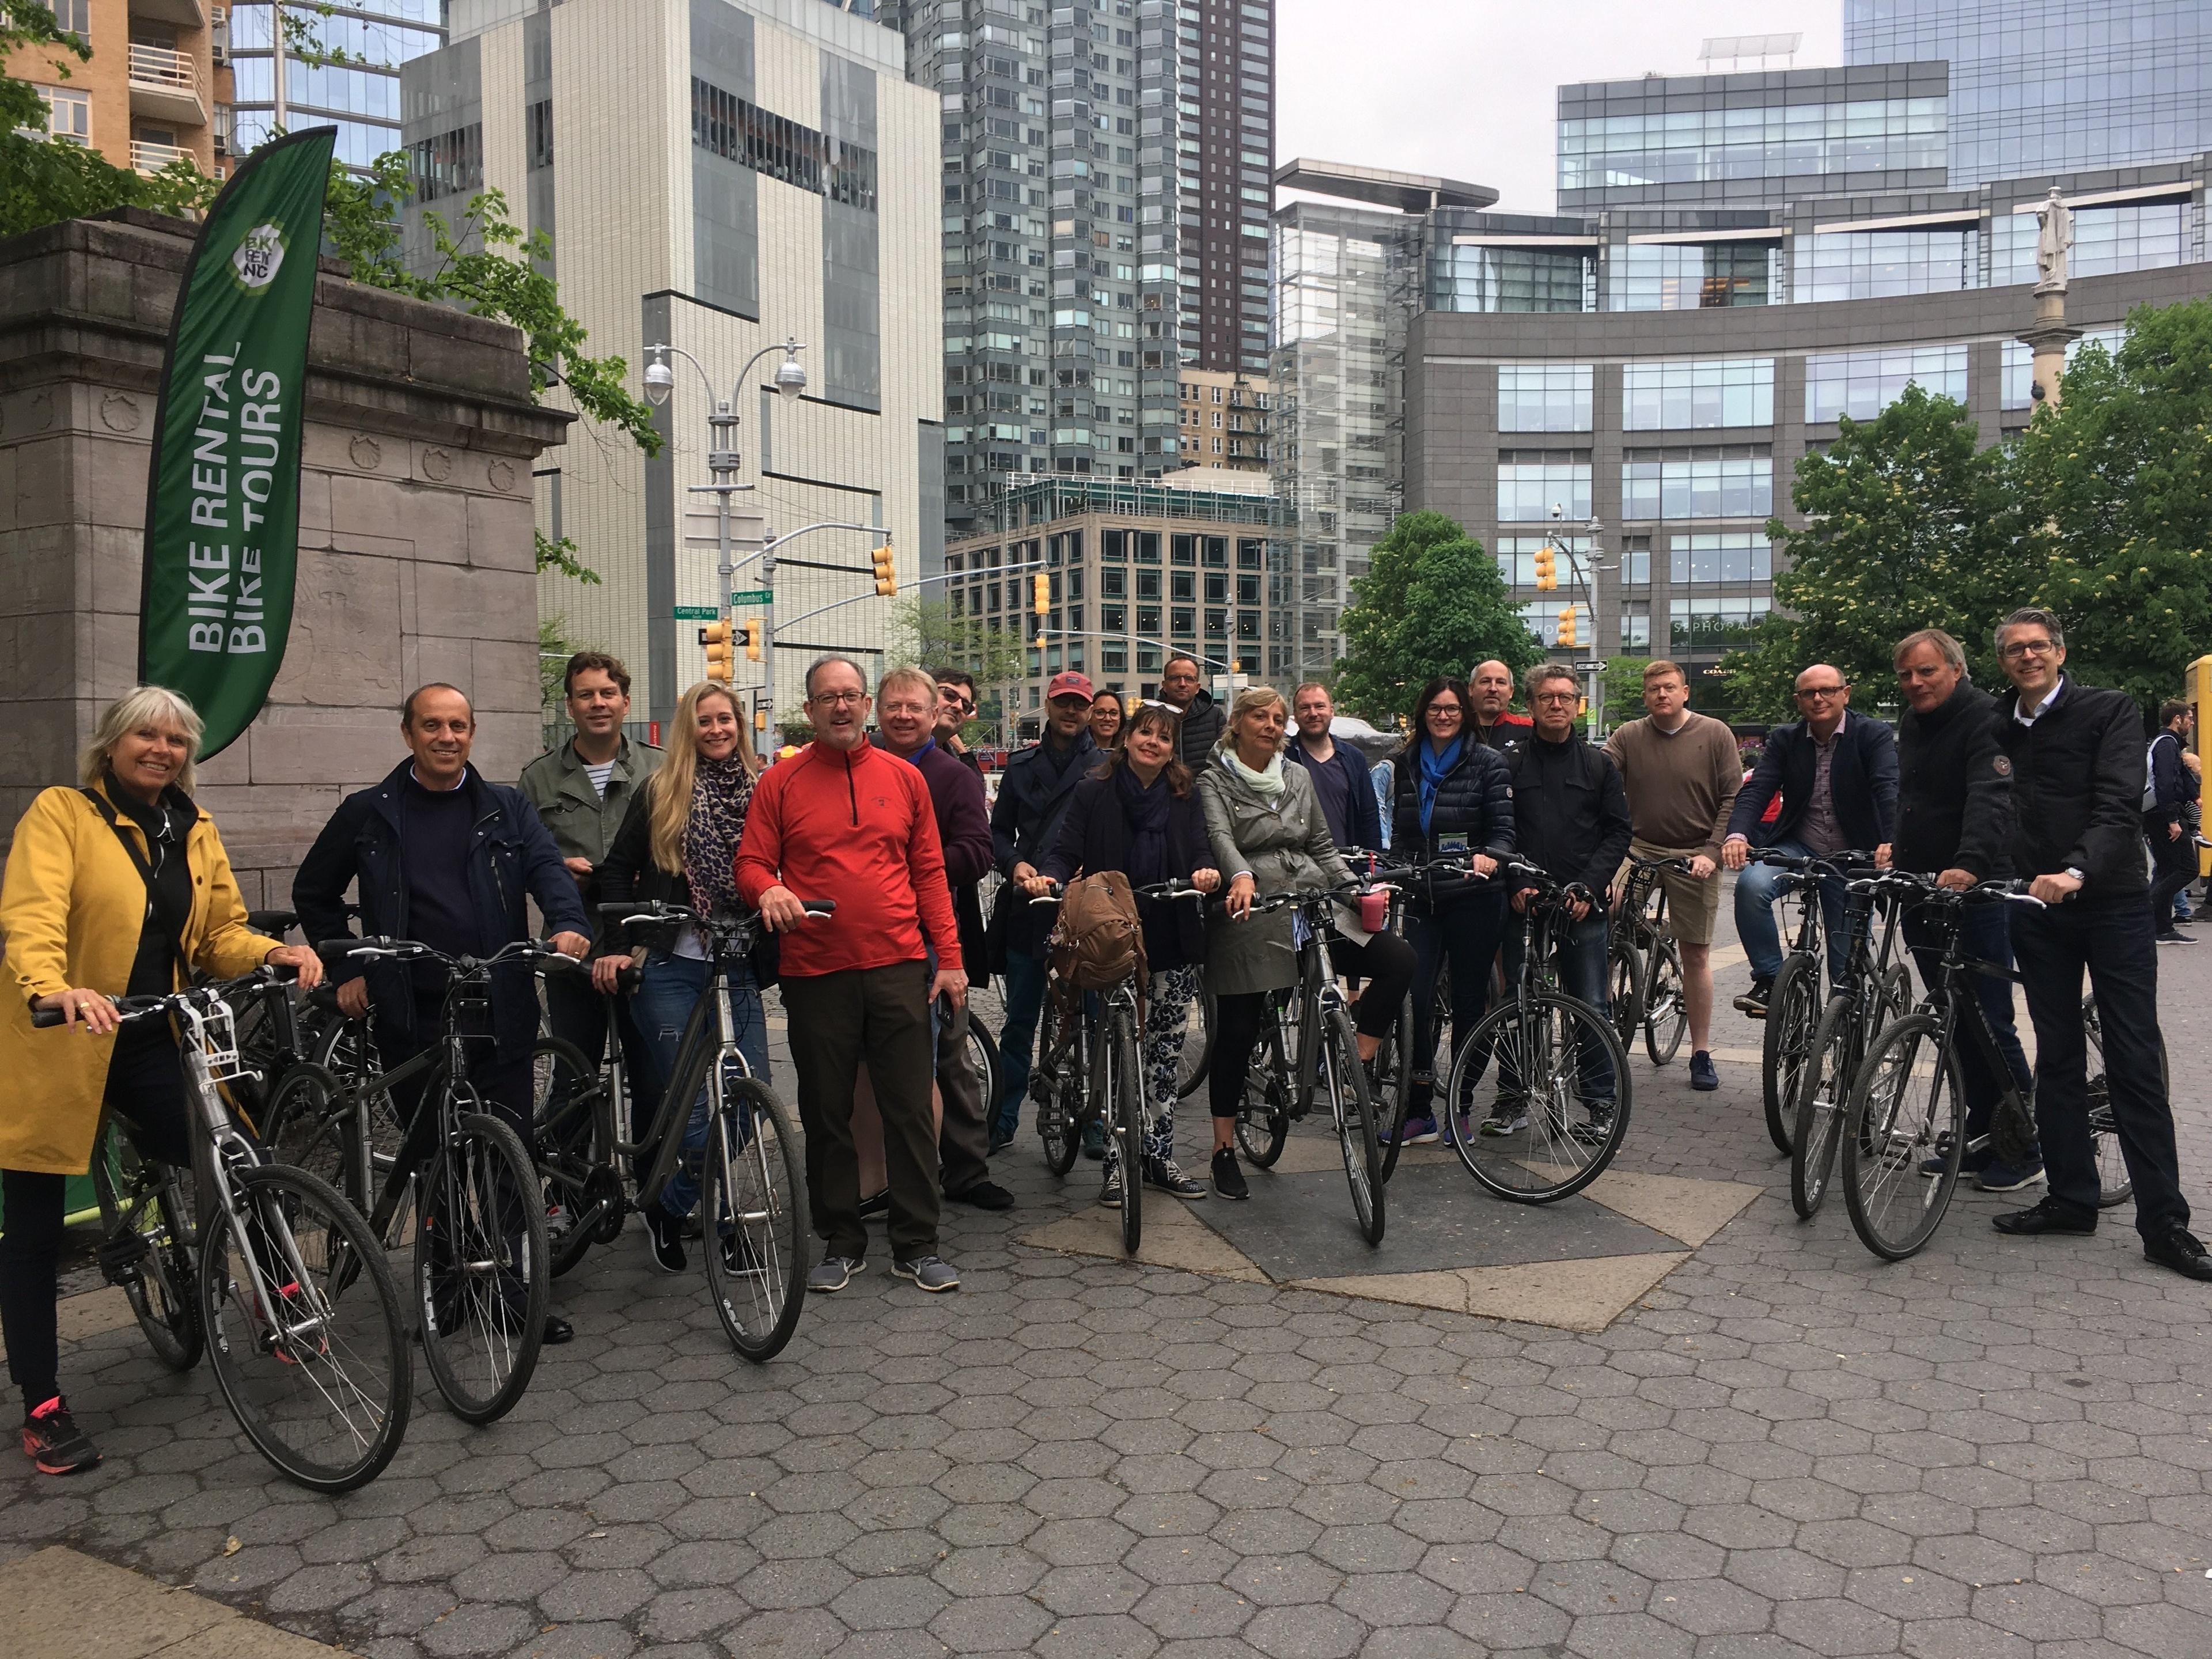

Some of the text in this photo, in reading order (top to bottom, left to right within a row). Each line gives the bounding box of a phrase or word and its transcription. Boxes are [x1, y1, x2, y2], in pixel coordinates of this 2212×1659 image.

[188, 342, 241, 652] BIKE RENTAL
[228, 368, 281, 653] BIKE TOURS
[733, 593, 763, 604] Columbus
[1674, 622, 1745, 632] SEPHORA
